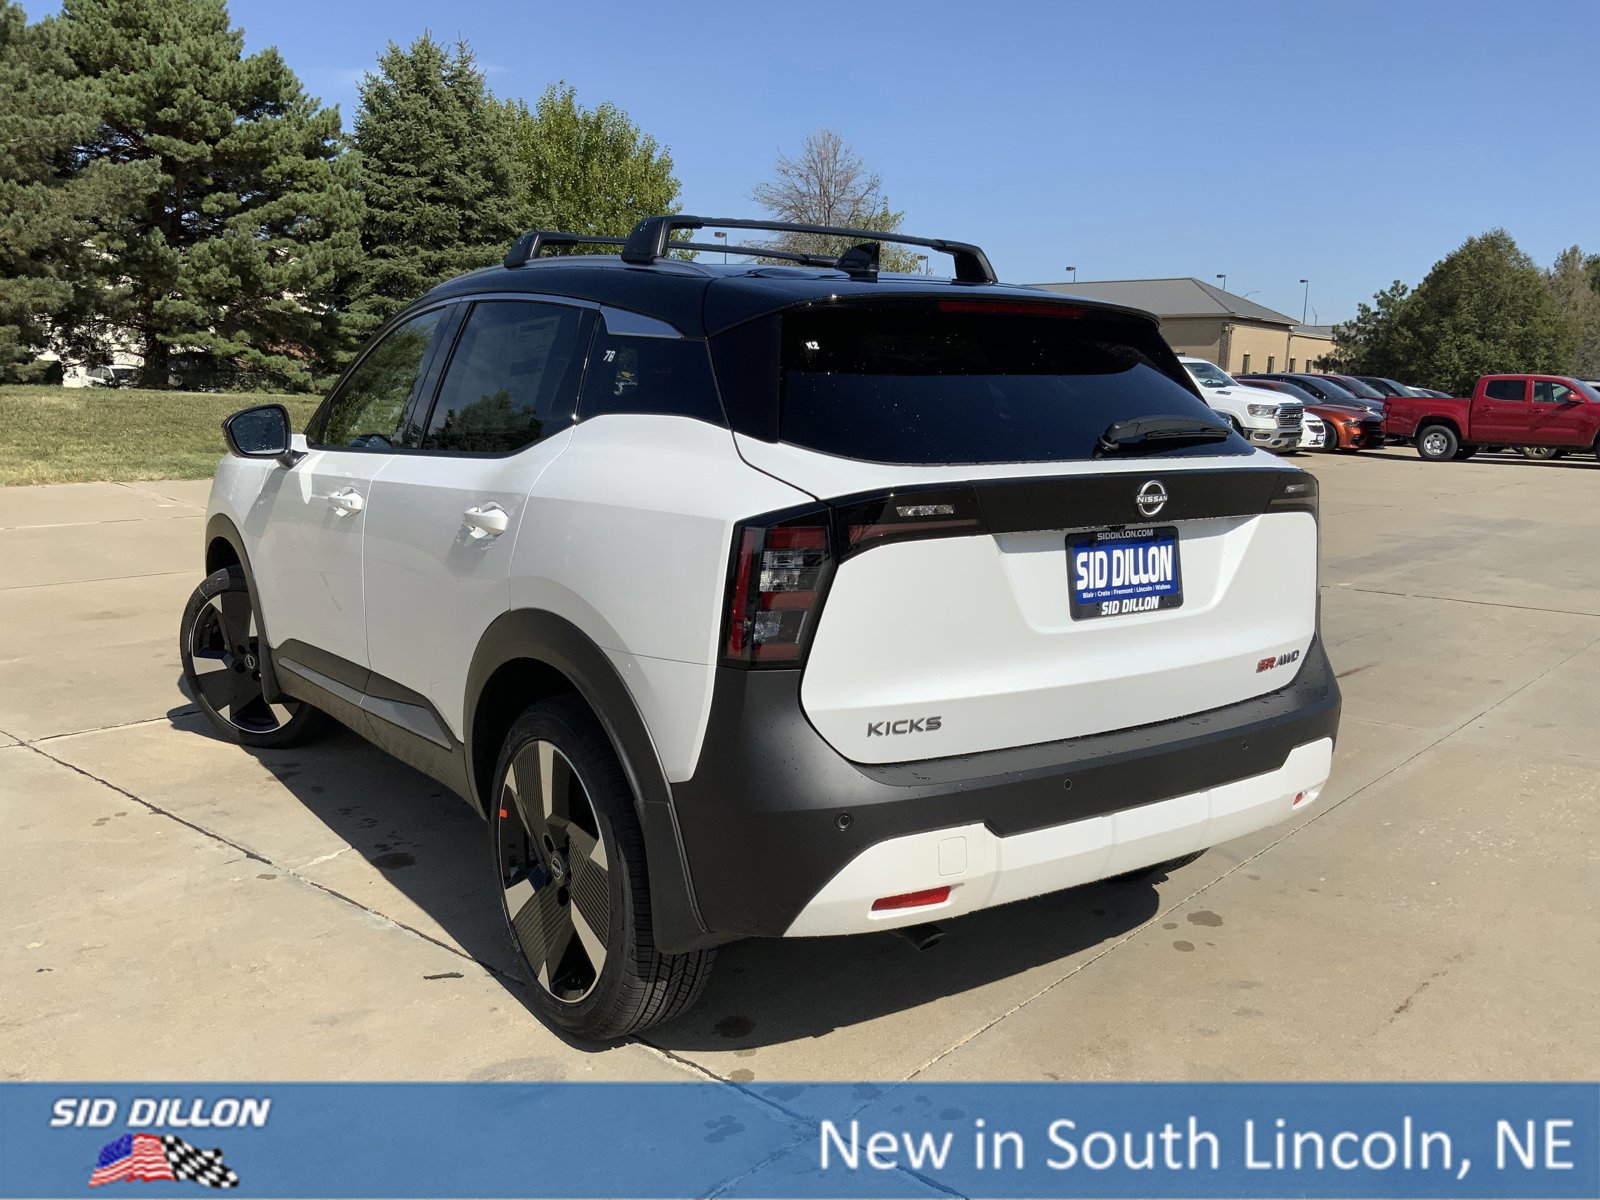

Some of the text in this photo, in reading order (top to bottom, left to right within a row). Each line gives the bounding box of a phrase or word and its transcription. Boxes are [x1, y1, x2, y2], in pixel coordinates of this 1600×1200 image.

[1137, 495, 1168, 503] NISSAN
[1097, 529, 1154, 540] SIDDILLON.COM
[1076, 545, 1173, 591] SID DILLON
[1136, 585, 1153, 593] Lincoln
[1101, 595, 1160, 616] SID DILLON
[1255, 649, 1300, 673] SR AWD
[866, 715, 942, 738] KICKS
